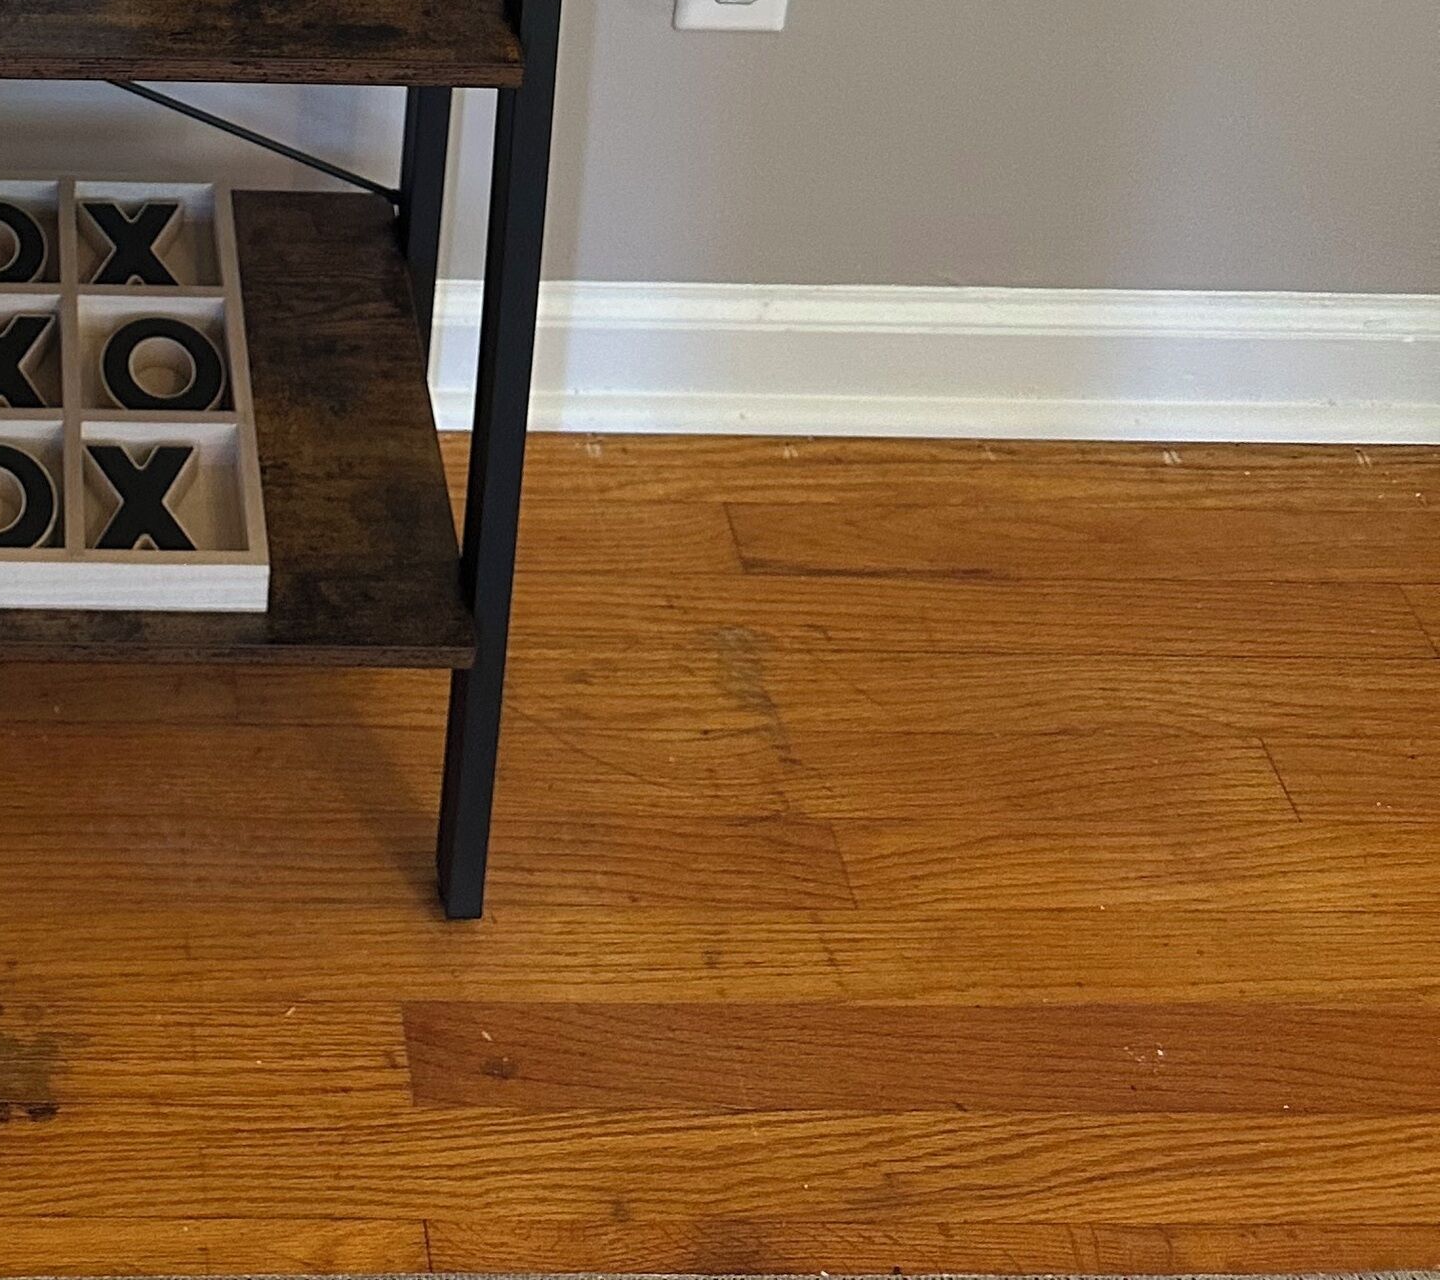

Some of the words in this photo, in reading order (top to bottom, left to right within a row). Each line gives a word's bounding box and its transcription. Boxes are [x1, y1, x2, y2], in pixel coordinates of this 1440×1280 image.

[79, 202, 181, 286] X
[100, 316, 227, 411] O
[84, 444, 200, 551] X
